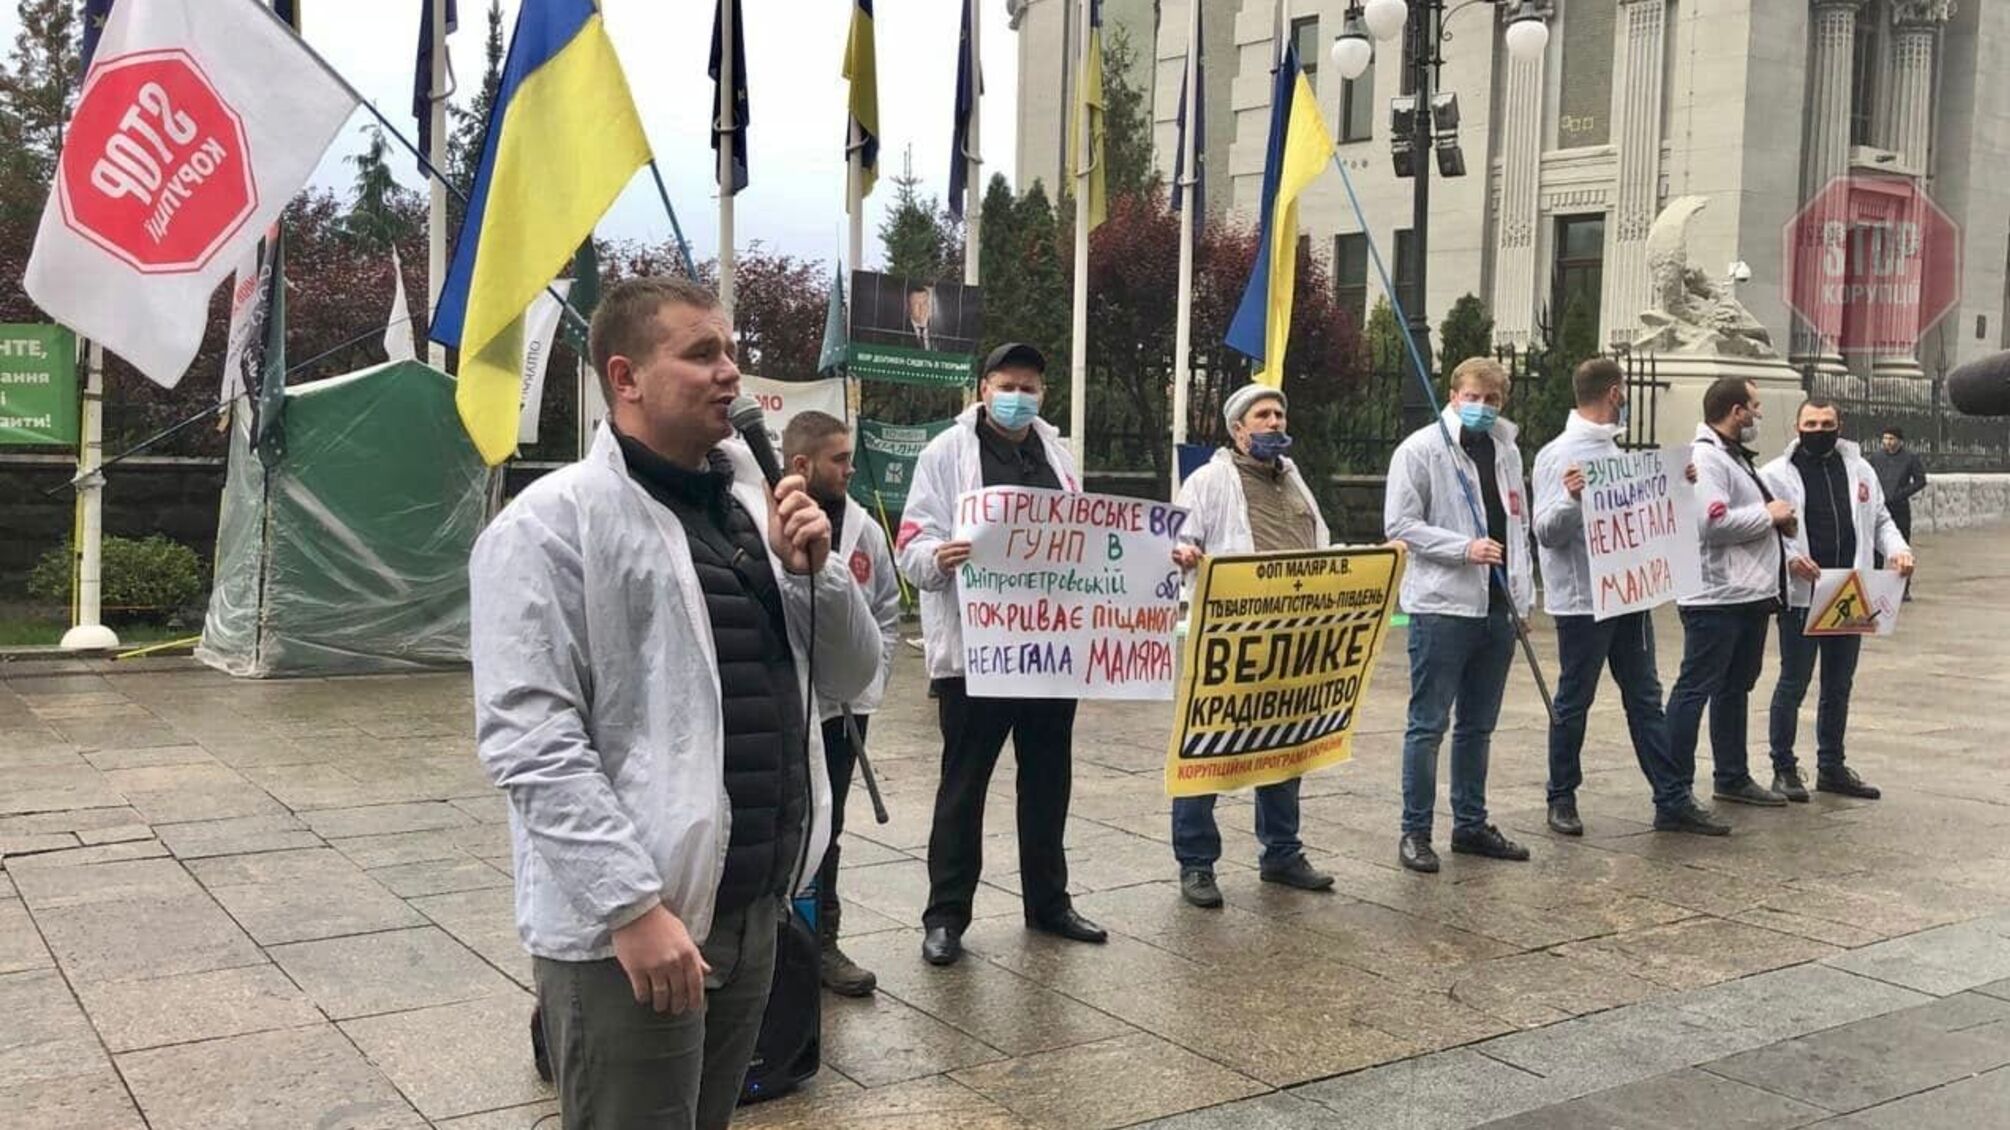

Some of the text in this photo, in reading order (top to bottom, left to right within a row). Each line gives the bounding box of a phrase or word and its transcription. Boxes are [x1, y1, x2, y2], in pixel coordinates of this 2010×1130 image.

[961, 491, 1187, 539] ПЕТРИКІВСЬКЕ ВП
[1588, 498, 1677, 556] НЕЛЕГАЛА
[1256, 562, 1282, 579] ФОП
[1286, 559, 1328, 578] МАЛЯР
[967, 599, 1084, 632] ПОКРИВАЄ
[968, 637, 1172, 685] НЕЛЕГАЛА МАЛЯРА
[1203, 623, 1371, 687] ВЕЛИКЕ
[1190, 675, 1358, 730] КРАДІВНИЦТВО
